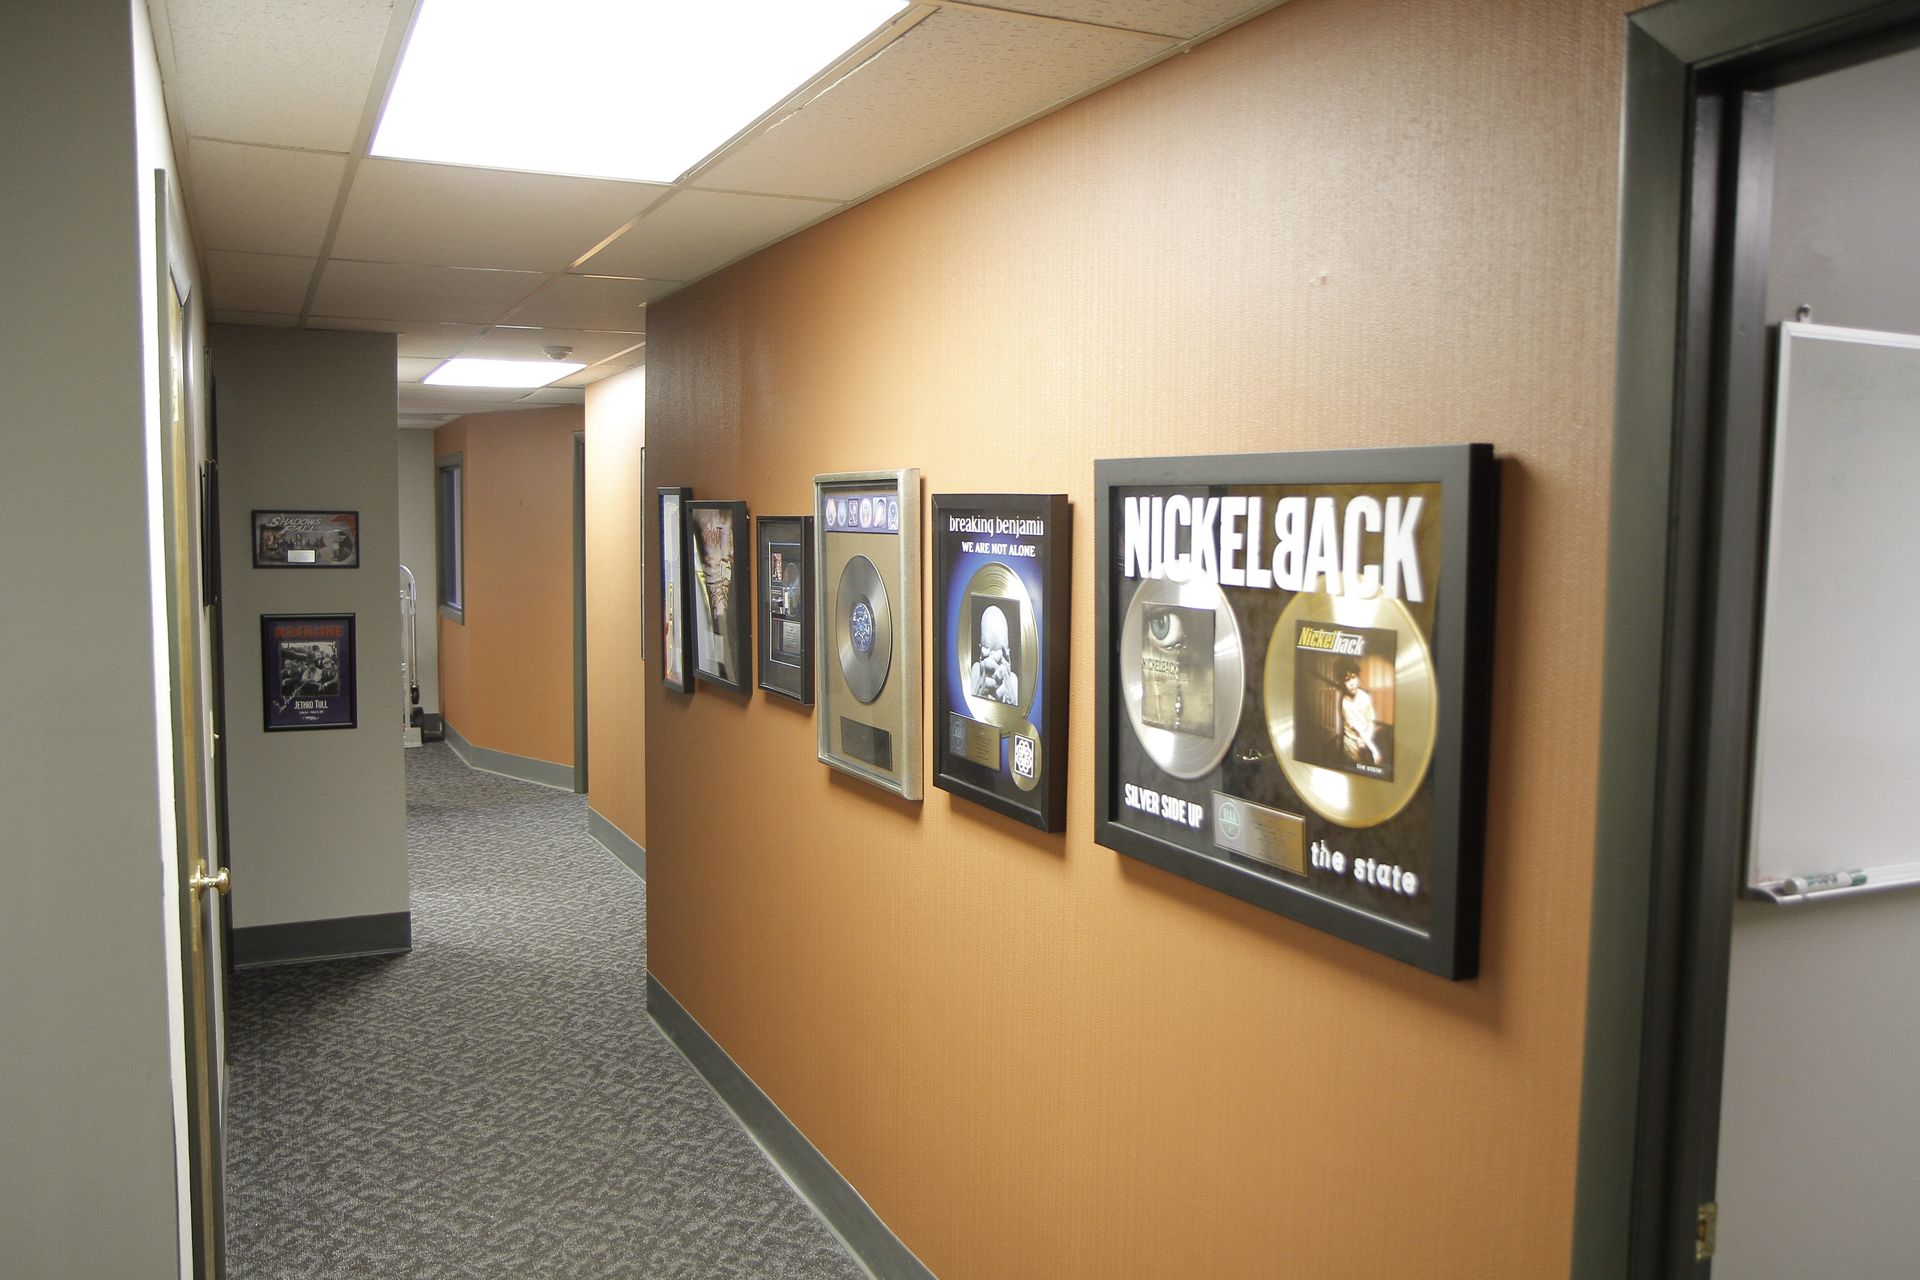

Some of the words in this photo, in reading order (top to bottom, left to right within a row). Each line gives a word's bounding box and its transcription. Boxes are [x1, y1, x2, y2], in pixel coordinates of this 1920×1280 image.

[949, 514, 994, 537] breaking
[961, 541, 974, 553] WE
[975, 542, 990, 554] ARE
[991, 543, 1007, 555] NOT
[1008, 544, 1036, 557] ALONE
[1123, 494, 1424, 603] NICKELBACK
[315, 699, 329, 709] TULL
[1124, 782, 1160, 815] SILVER
[1161, 794, 1187, 823] SIDE
[1187, 801, 1203, 828] UP
[1310, 839, 1345, 873] the
[1353, 857, 1418, 896] state
